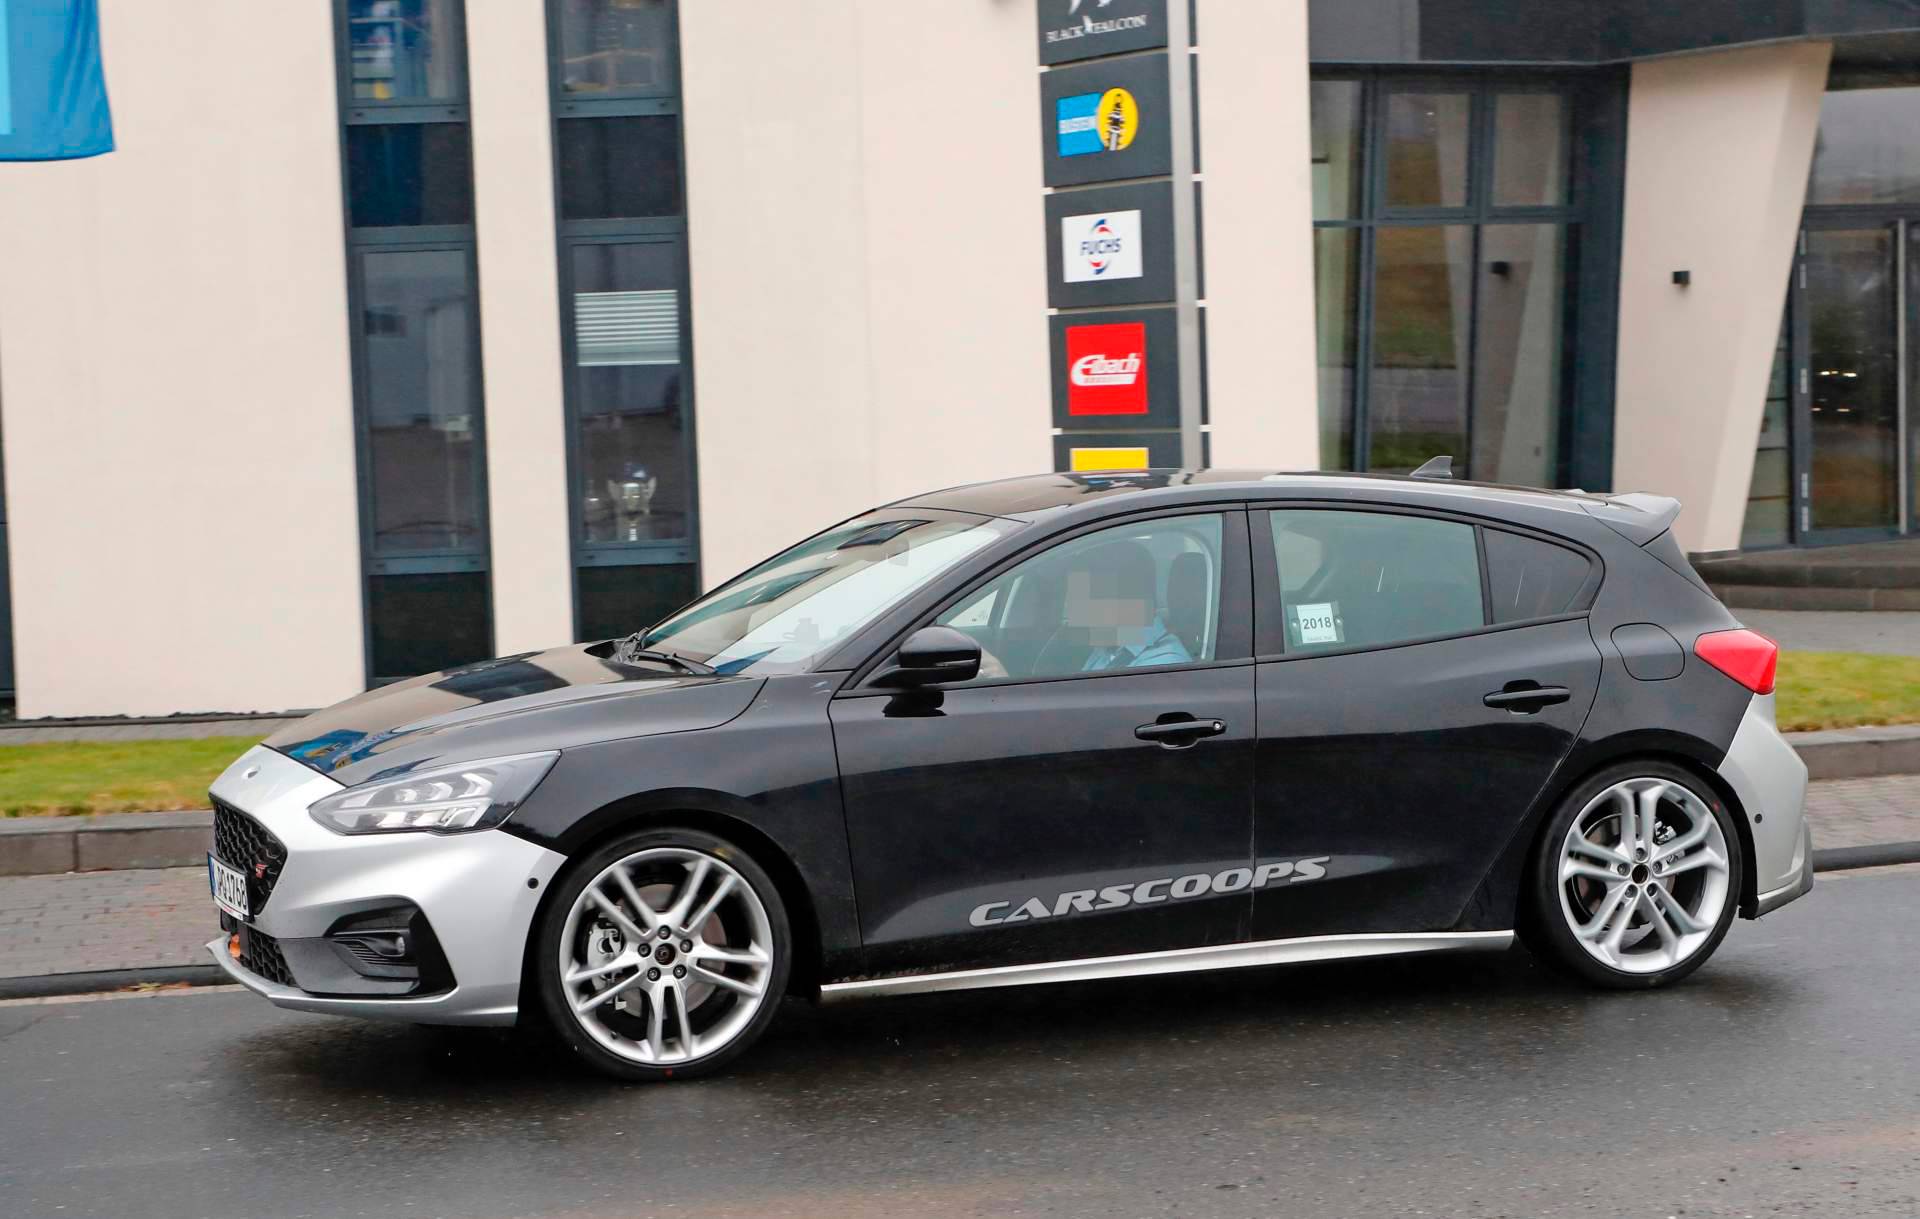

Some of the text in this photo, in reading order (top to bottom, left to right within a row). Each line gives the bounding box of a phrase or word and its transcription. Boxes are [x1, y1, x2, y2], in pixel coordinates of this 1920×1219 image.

[1046, 14, 1147, 43] BLACK FALCON
[1080, 238, 1121, 256] FUCHS
[1302, 616, 1332, 630] 2018
